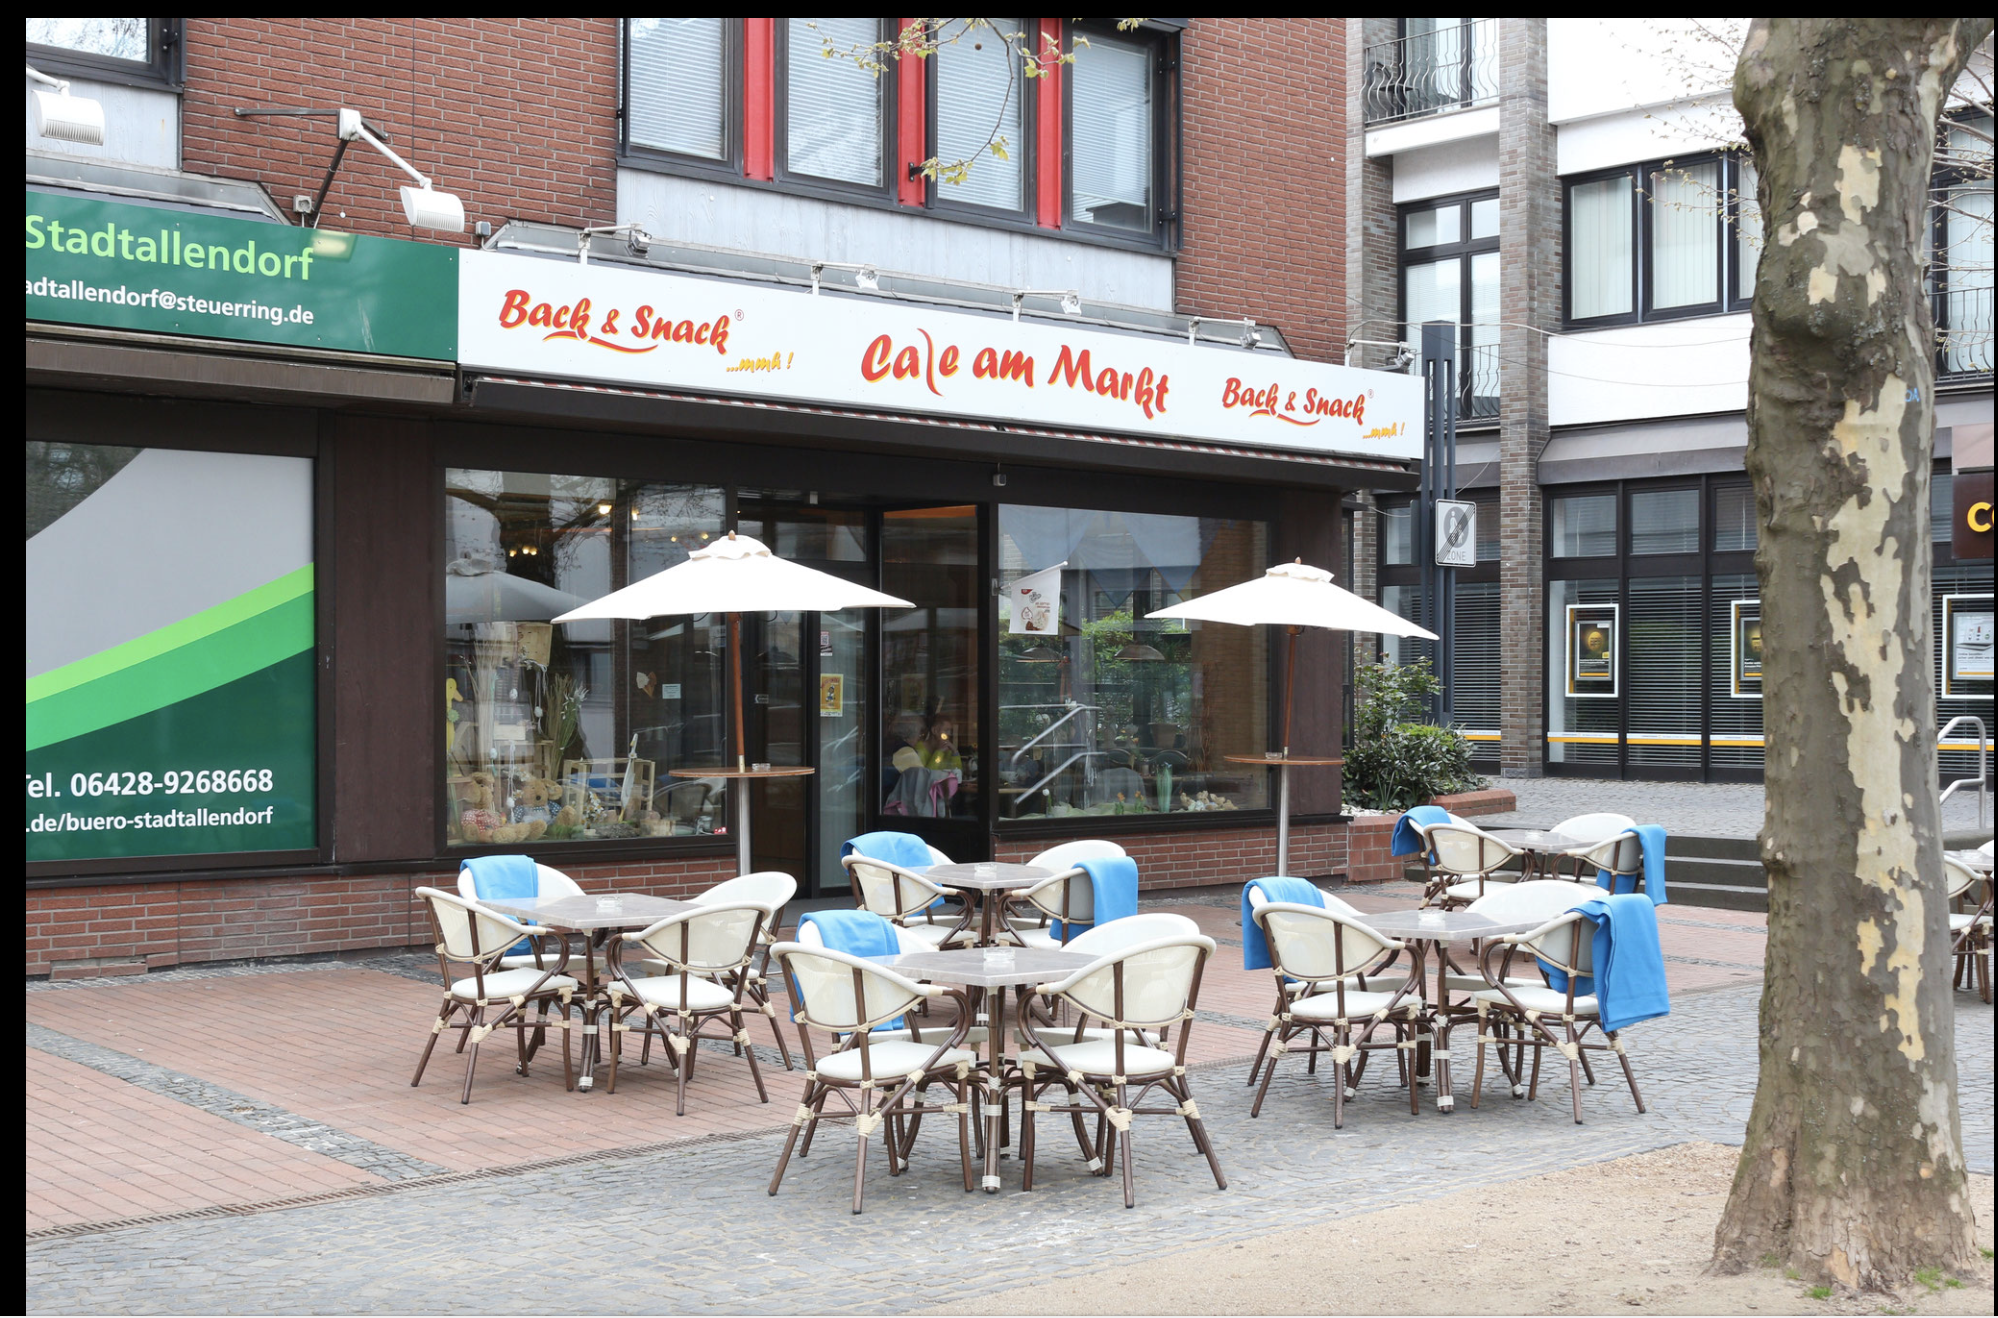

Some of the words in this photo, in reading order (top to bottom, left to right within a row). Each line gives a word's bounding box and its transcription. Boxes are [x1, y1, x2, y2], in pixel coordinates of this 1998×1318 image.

[26, 214, 314, 280] Stadtallendorf
[499, 289, 591, 341] Back
[600, 308, 620, 335] &
[630, 305, 730, 356] Snack
[972, 347, 1035, 388] am
[1047, 344, 1169, 420] Markt
[1222, 377, 1279, 416] Back
[1284, 391, 1297, 412] &
[1303, 387, 1366, 426] Snack
[1967, 501, 1994, 533] C
[70, 769, 273, 798] 06428-9268668
